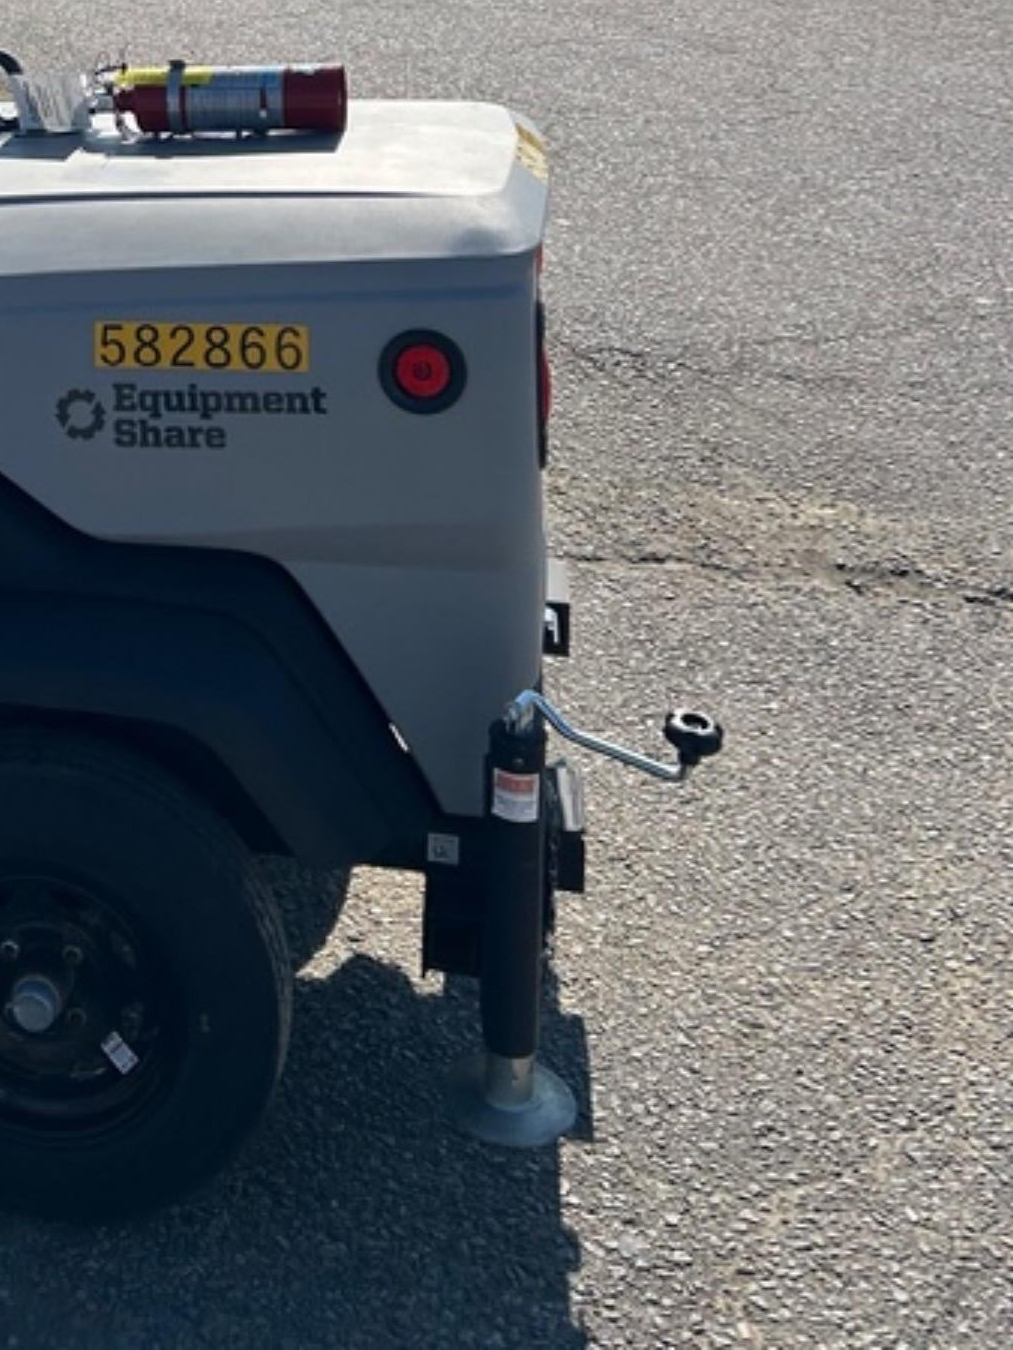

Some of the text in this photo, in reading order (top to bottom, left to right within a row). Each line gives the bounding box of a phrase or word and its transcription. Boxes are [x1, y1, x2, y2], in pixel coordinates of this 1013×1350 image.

[99, 322, 304, 371] 582866
[113, 383, 328, 418] Equipment
[114, 419, 227, 449] Share
